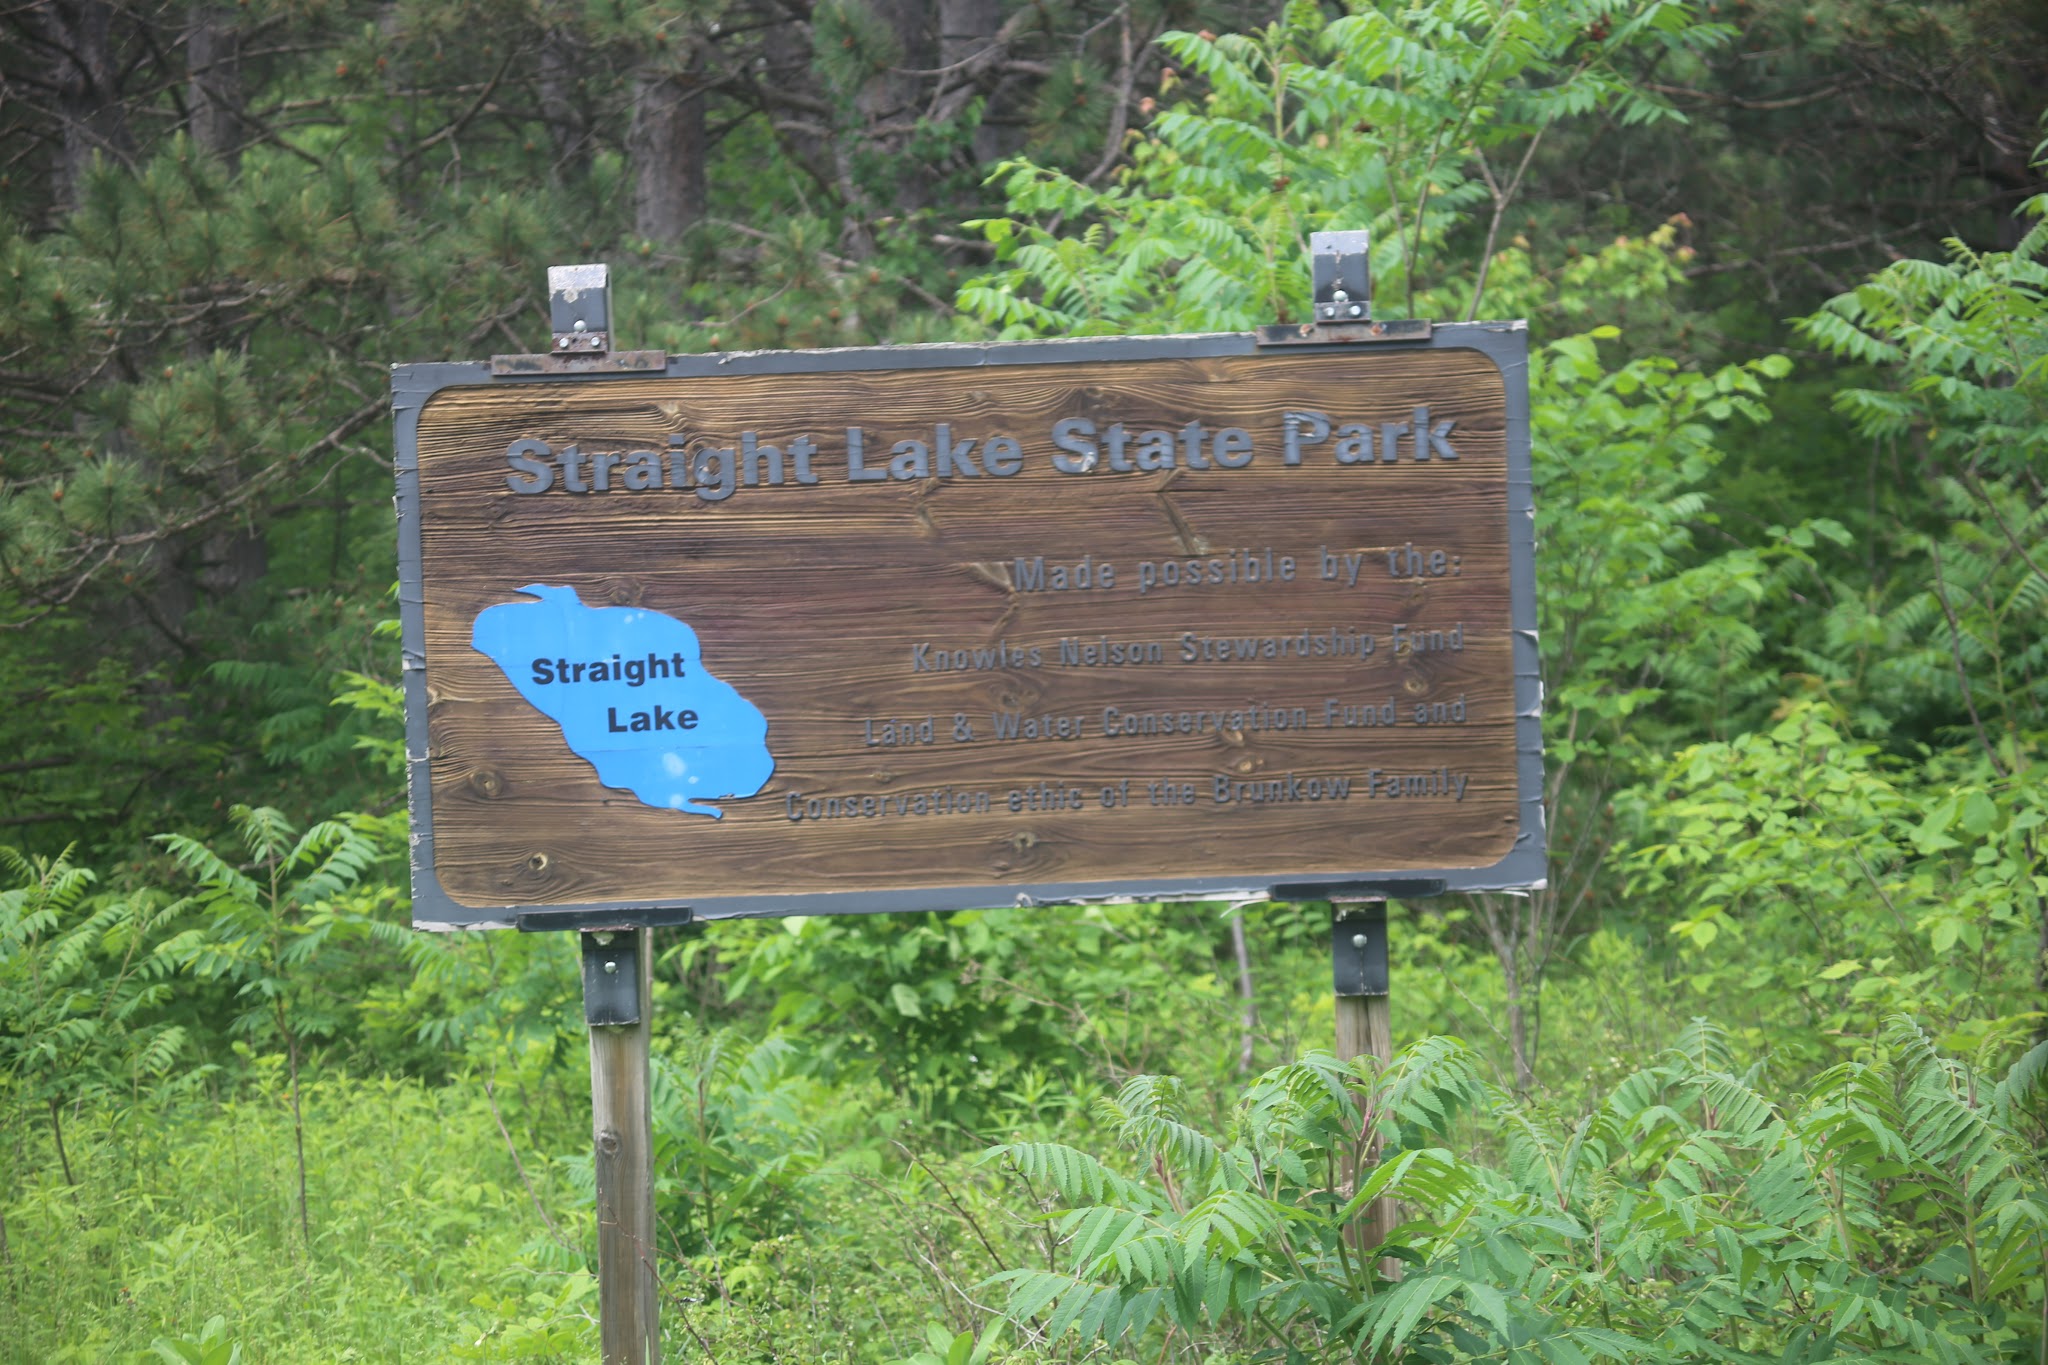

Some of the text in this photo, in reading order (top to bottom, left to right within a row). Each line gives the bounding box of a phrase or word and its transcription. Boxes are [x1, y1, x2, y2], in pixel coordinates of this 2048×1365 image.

[506, 405, 1460, 500] Straight Lake State Park
[1014, 542, 1462, 593] Made possible by the:
[531, 652, 686, 687] Straight
[912, 622, 1464, 672] Knowles Nelson Stewardship Fund
[607, 705, 699, 733] Lake
[865, 693, 1467, 747] Land & Water Conservation Fund and
[785, 767, 1469, 820] Conservation ethic of the Brunkow Family
